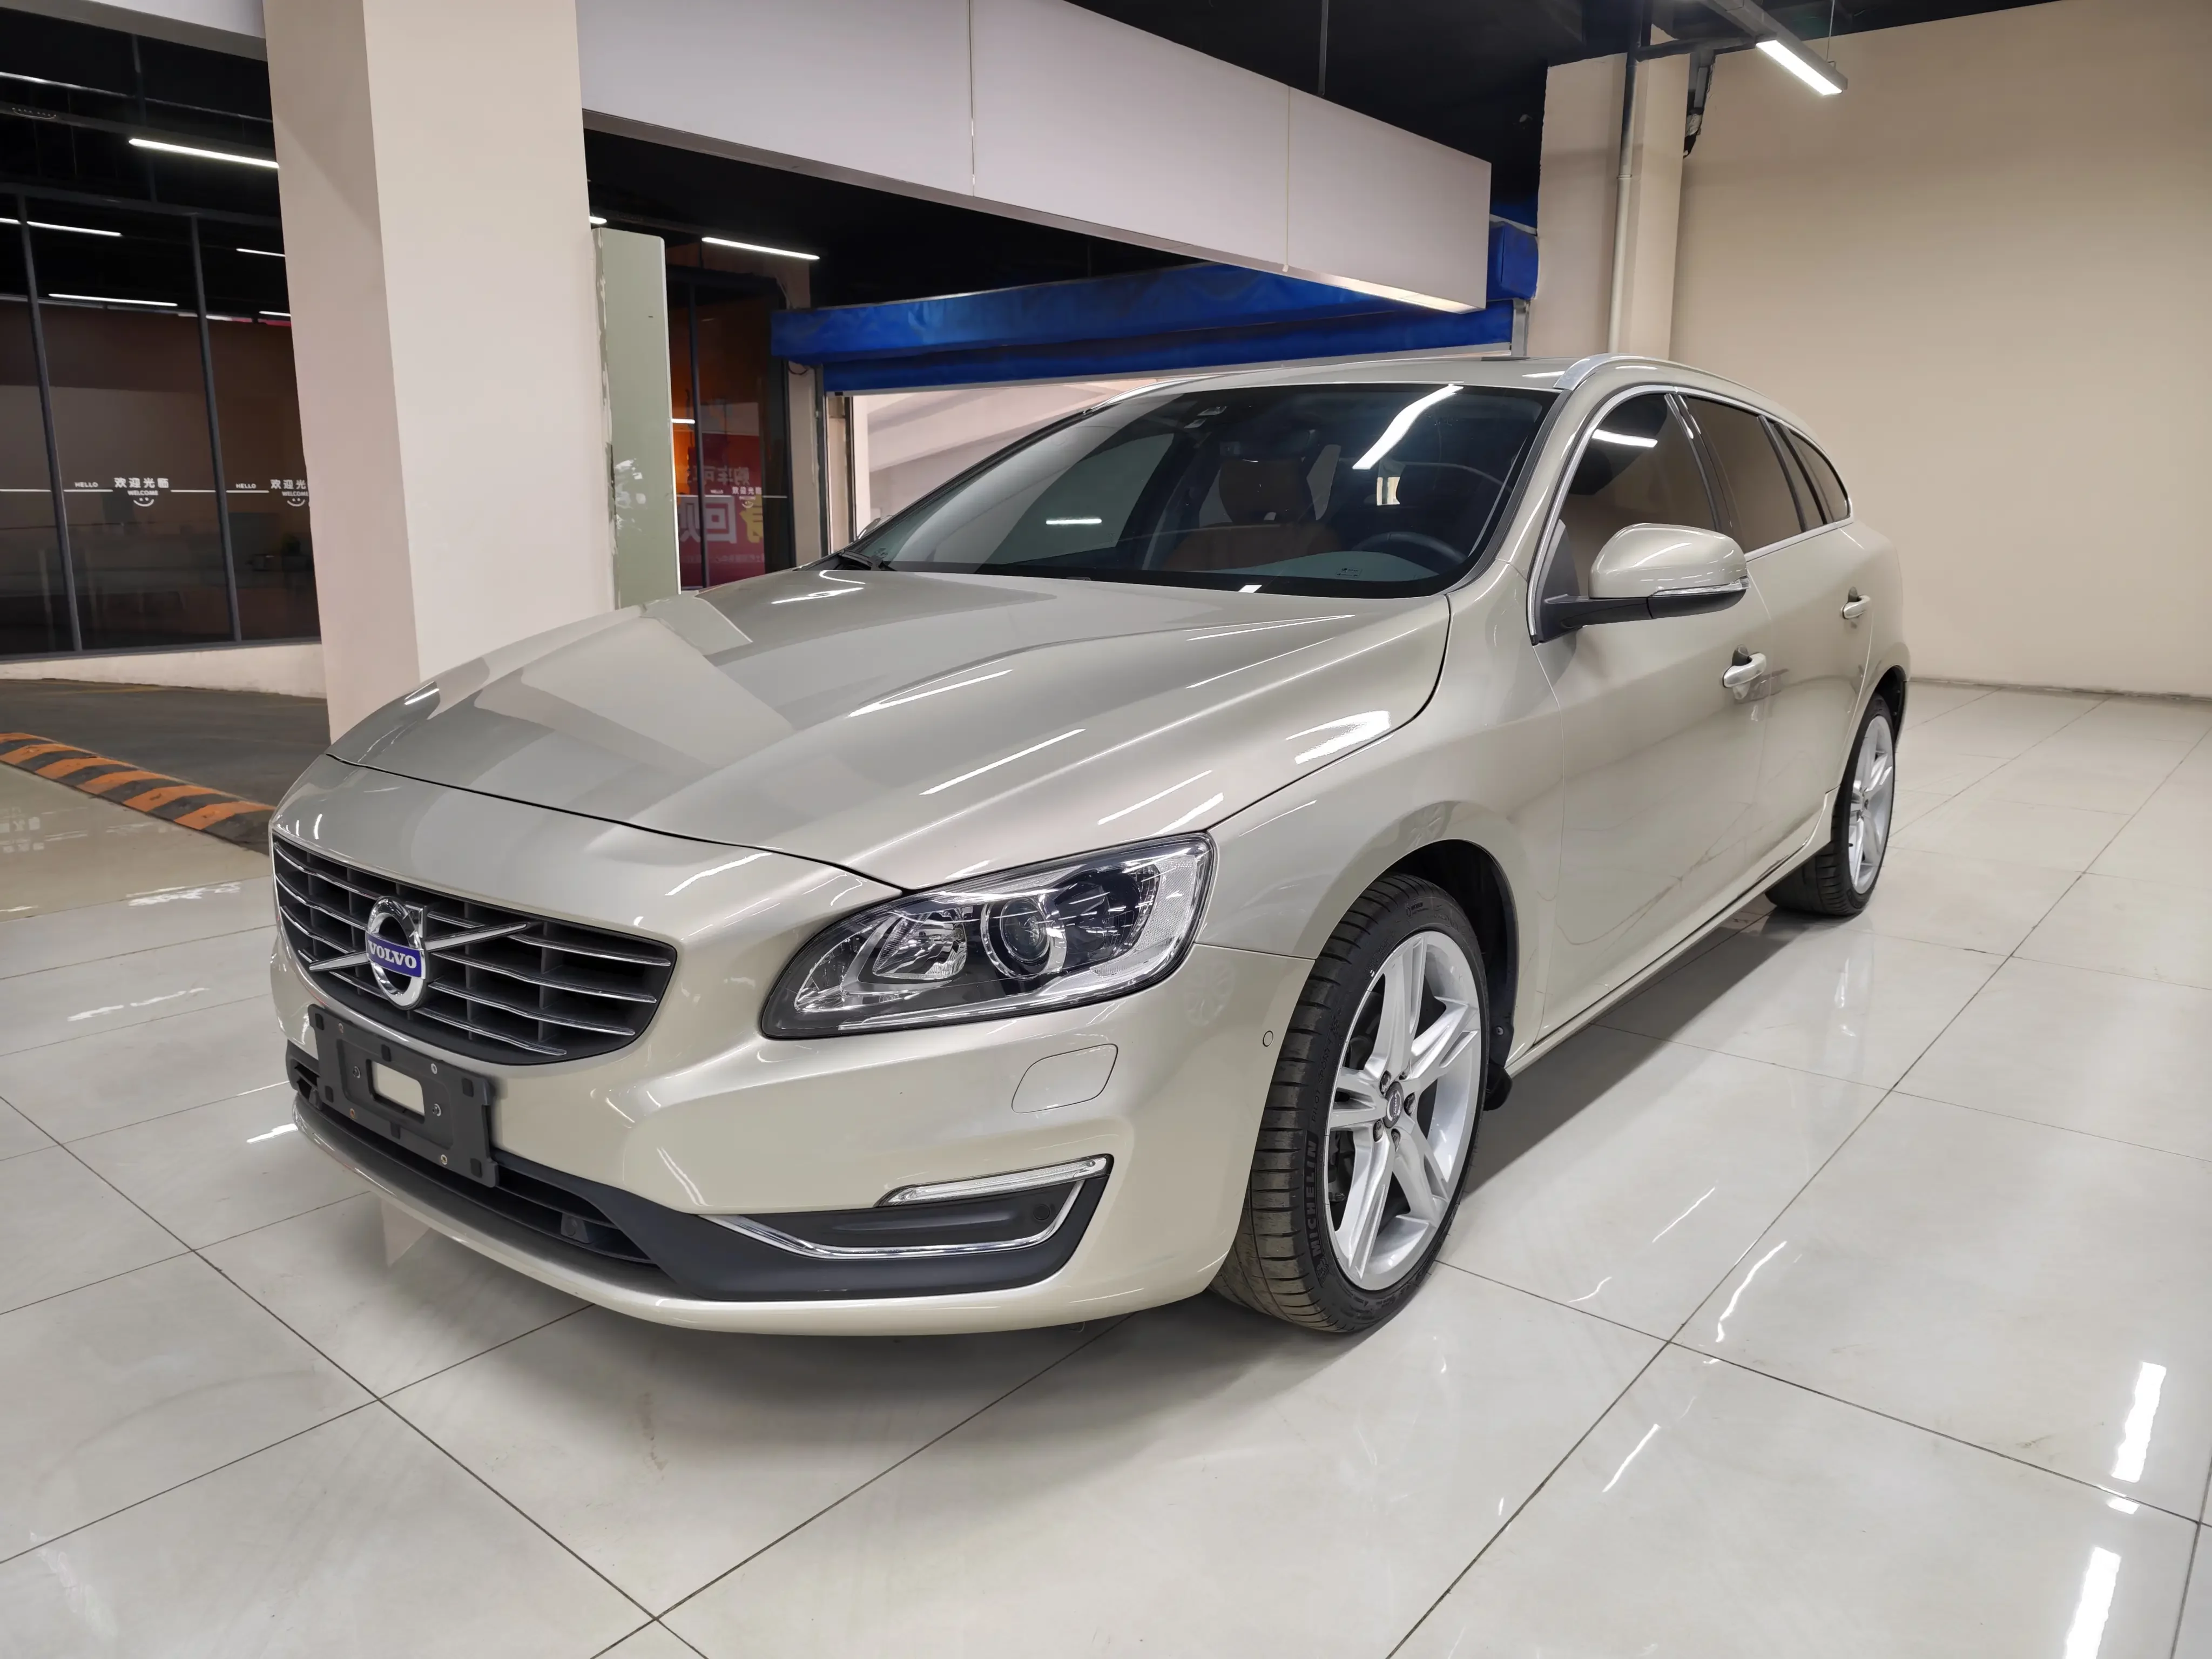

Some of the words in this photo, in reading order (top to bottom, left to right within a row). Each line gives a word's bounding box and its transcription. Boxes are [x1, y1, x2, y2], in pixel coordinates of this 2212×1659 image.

[114, 477, 169, 488] 欢迎光临
[368, 940, 416, 968] VOLVO
[1312, 1088, 1321, 1122] PILOT
[1306, 1140, 1322, 1257] MICHELIN
